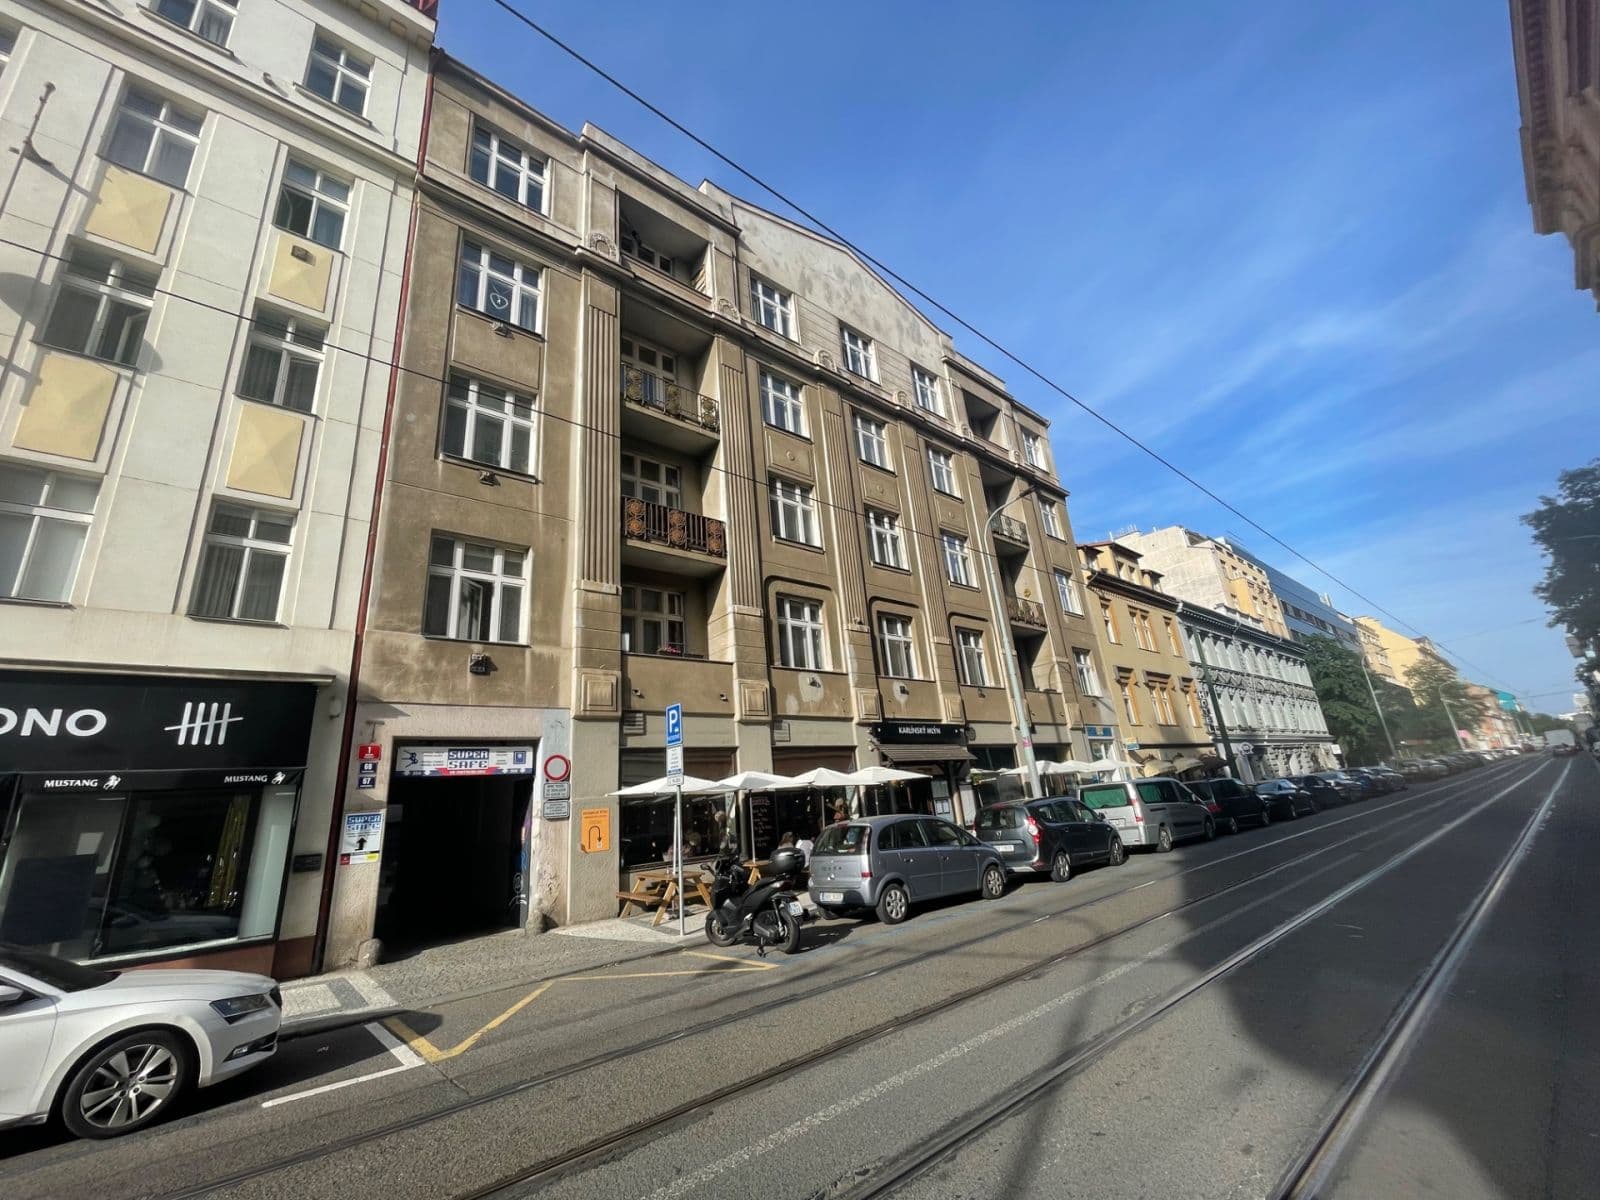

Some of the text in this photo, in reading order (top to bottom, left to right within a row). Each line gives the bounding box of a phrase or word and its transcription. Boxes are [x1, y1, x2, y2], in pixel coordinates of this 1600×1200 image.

[668, 709, 678, 733] P
[449, 750, 488, 759] SUPER
[448, 760, 488, 769] SAFE
[44, 778, 99, 788] MUSTANG
[223, 774, 268, 784] MUSTANG
